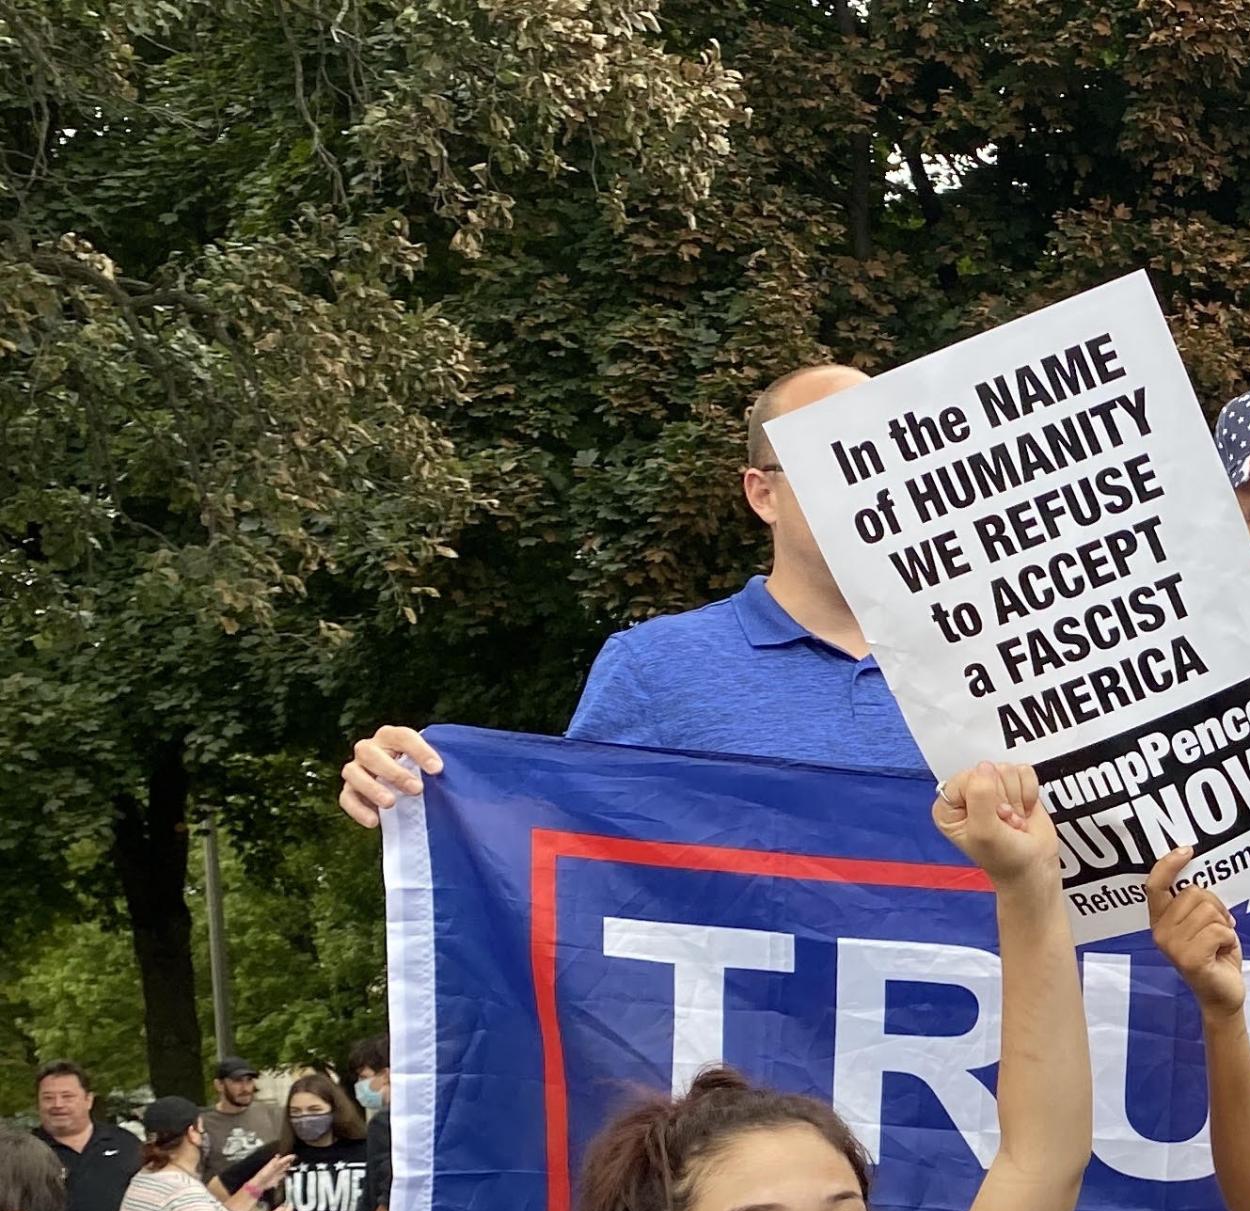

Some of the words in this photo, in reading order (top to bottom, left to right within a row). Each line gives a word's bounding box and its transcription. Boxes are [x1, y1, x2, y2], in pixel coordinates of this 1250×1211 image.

[831, 439, 885, 486] In
[888, 404, 970, 461] the
[975, 332, 1126, 428] NAME
[854, 490, 902, 544] of
[905, 387, 1155, 524] HUMANITY
[889, 530, 971, 593] WE
[973, 453, 1165, 564] REFUSE
[931, 601, 983, 643] to
[989, 516, 1167, 626] ACCEPT
[964, 663, 995, 698] a
[996, 573, 1190, 685] FASCIST
[994, 634, 1209, 750] AMERICA
